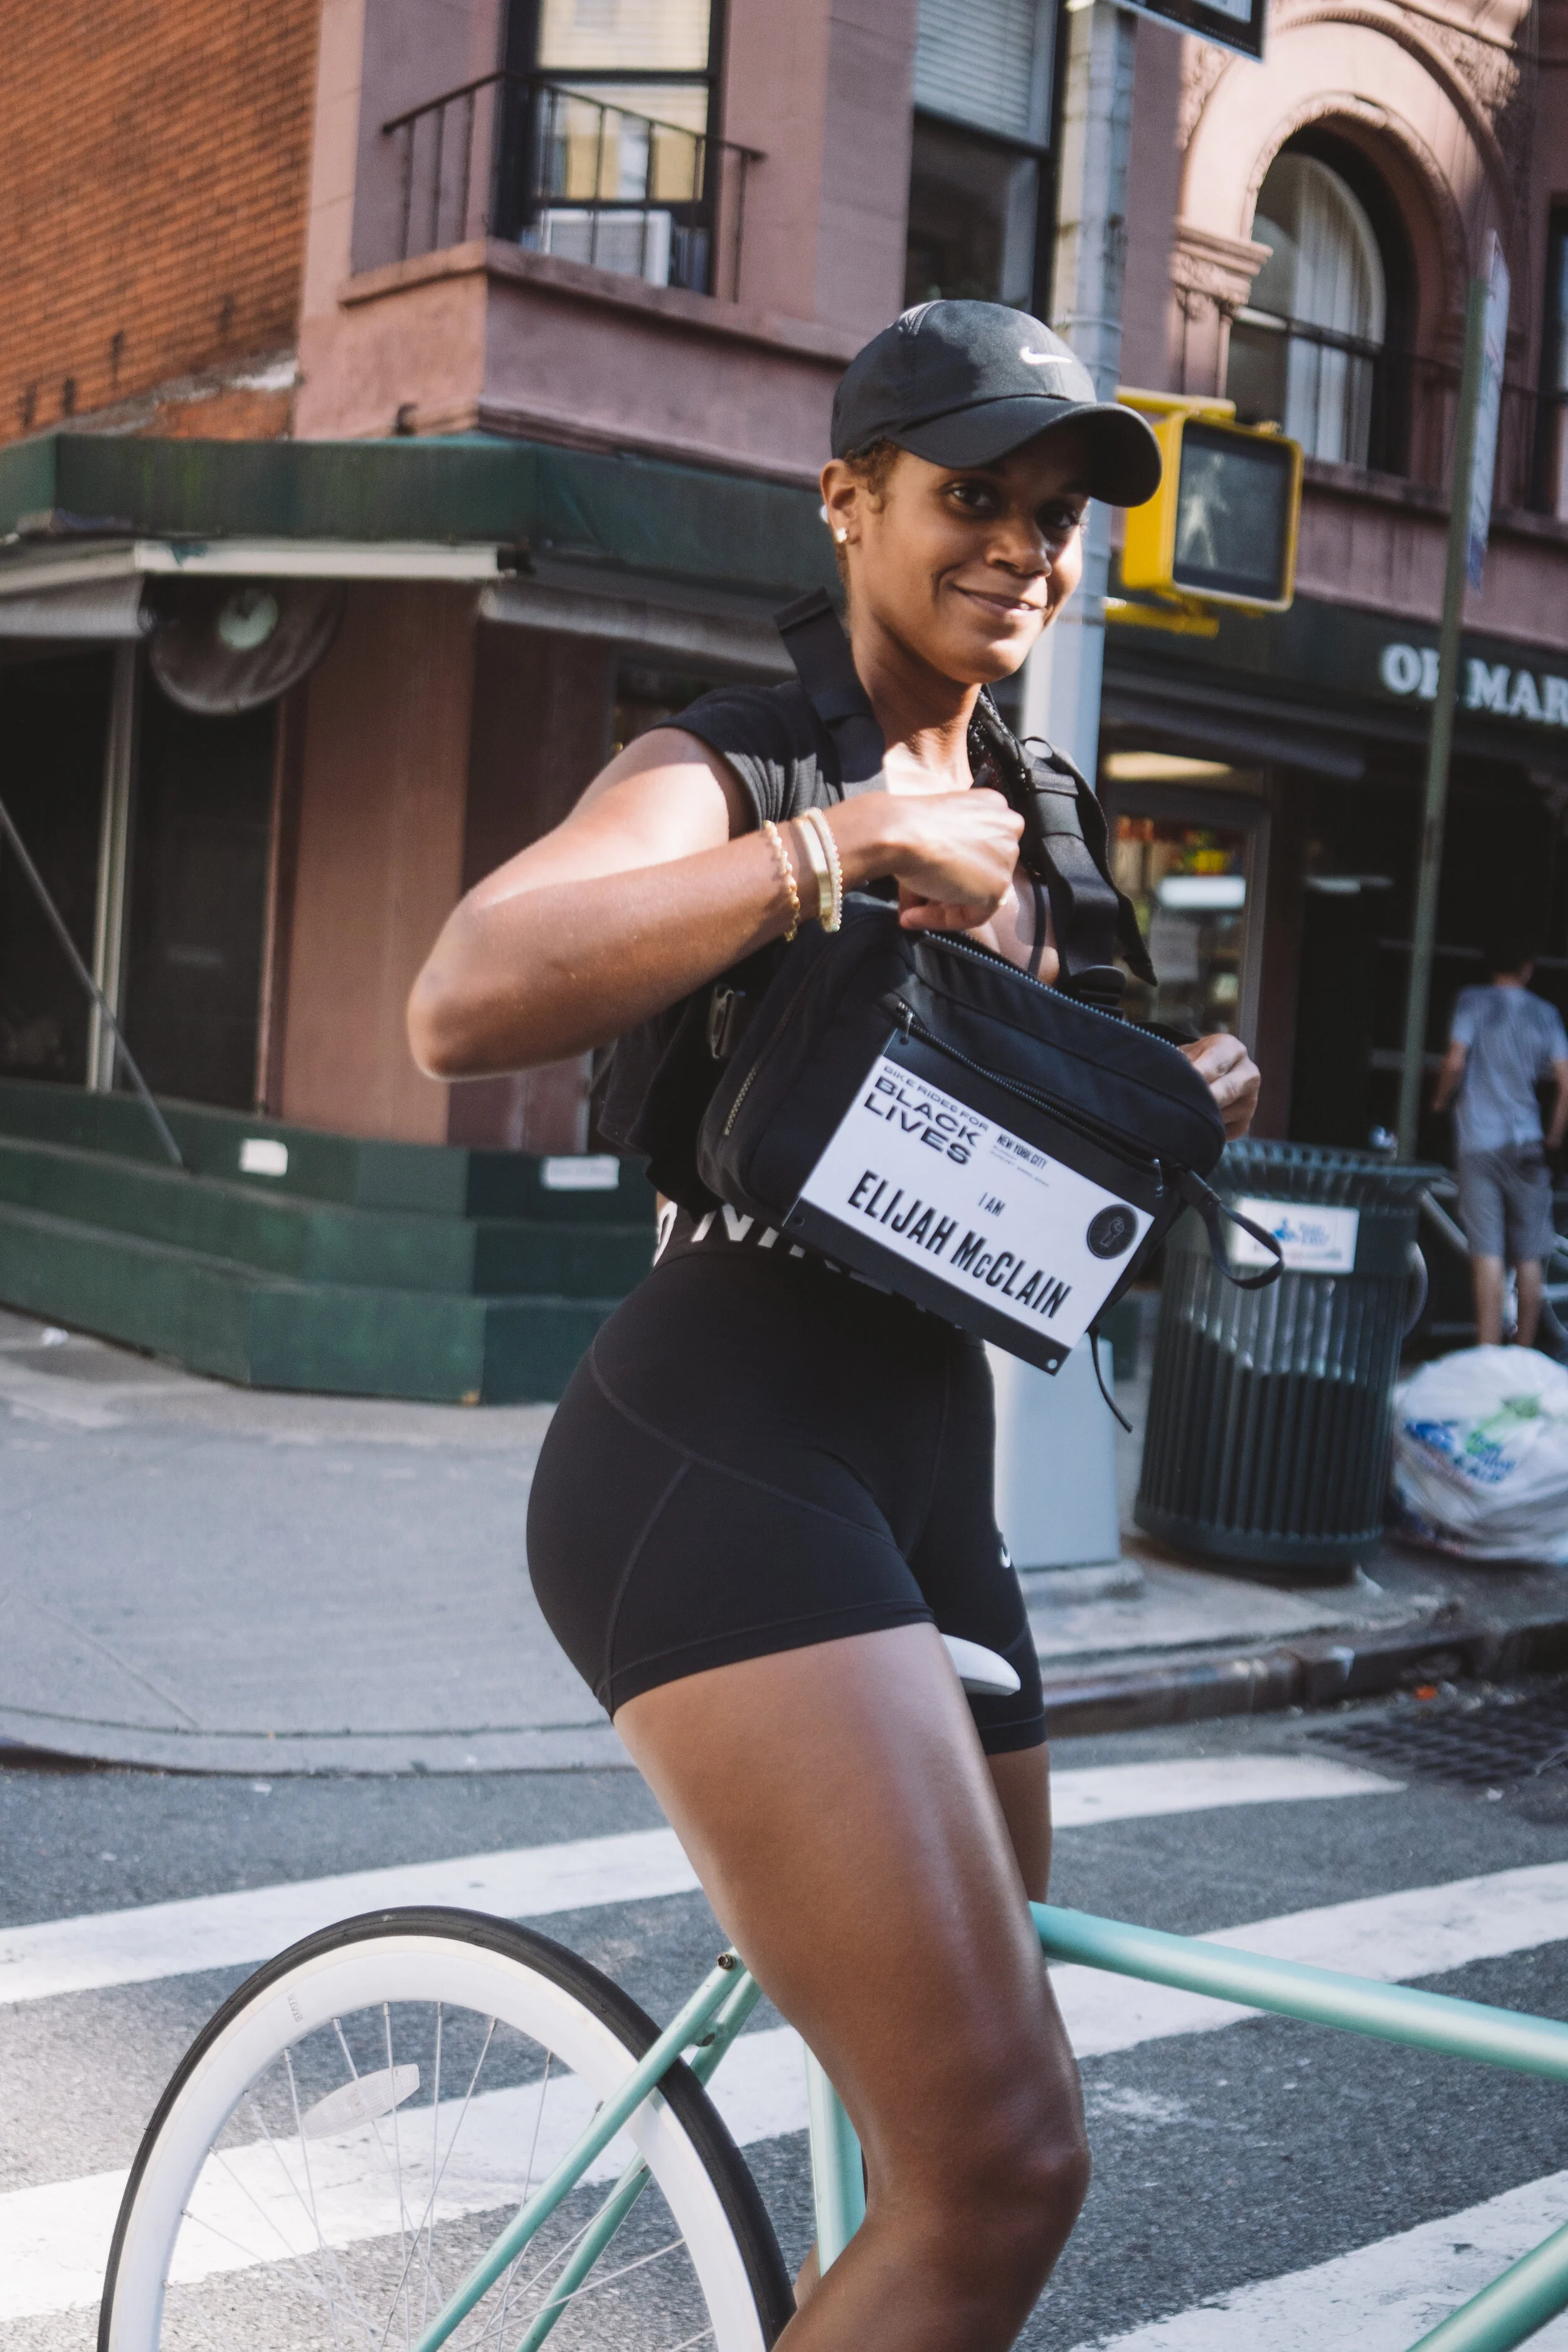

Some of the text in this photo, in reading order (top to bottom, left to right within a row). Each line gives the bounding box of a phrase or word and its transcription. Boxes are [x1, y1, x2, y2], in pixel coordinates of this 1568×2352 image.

[864, 1092, 971, 1165] LIVES
[875, 1076, 981, 1147] BLACK
[884, 1066, 988, 1131] BIKE RIDES FOR
[997, 1134, 1015, 1149] NEW
[1014, 1143, 1032, 1162] YORK
[1030, 1154, 1048, 1169] CITY
[978, 1192, 1006, 1217] I AM
[847, 1169, 960, 1255] ELIJAH
[950, 1230, 1073, 1318] McCLAIN
